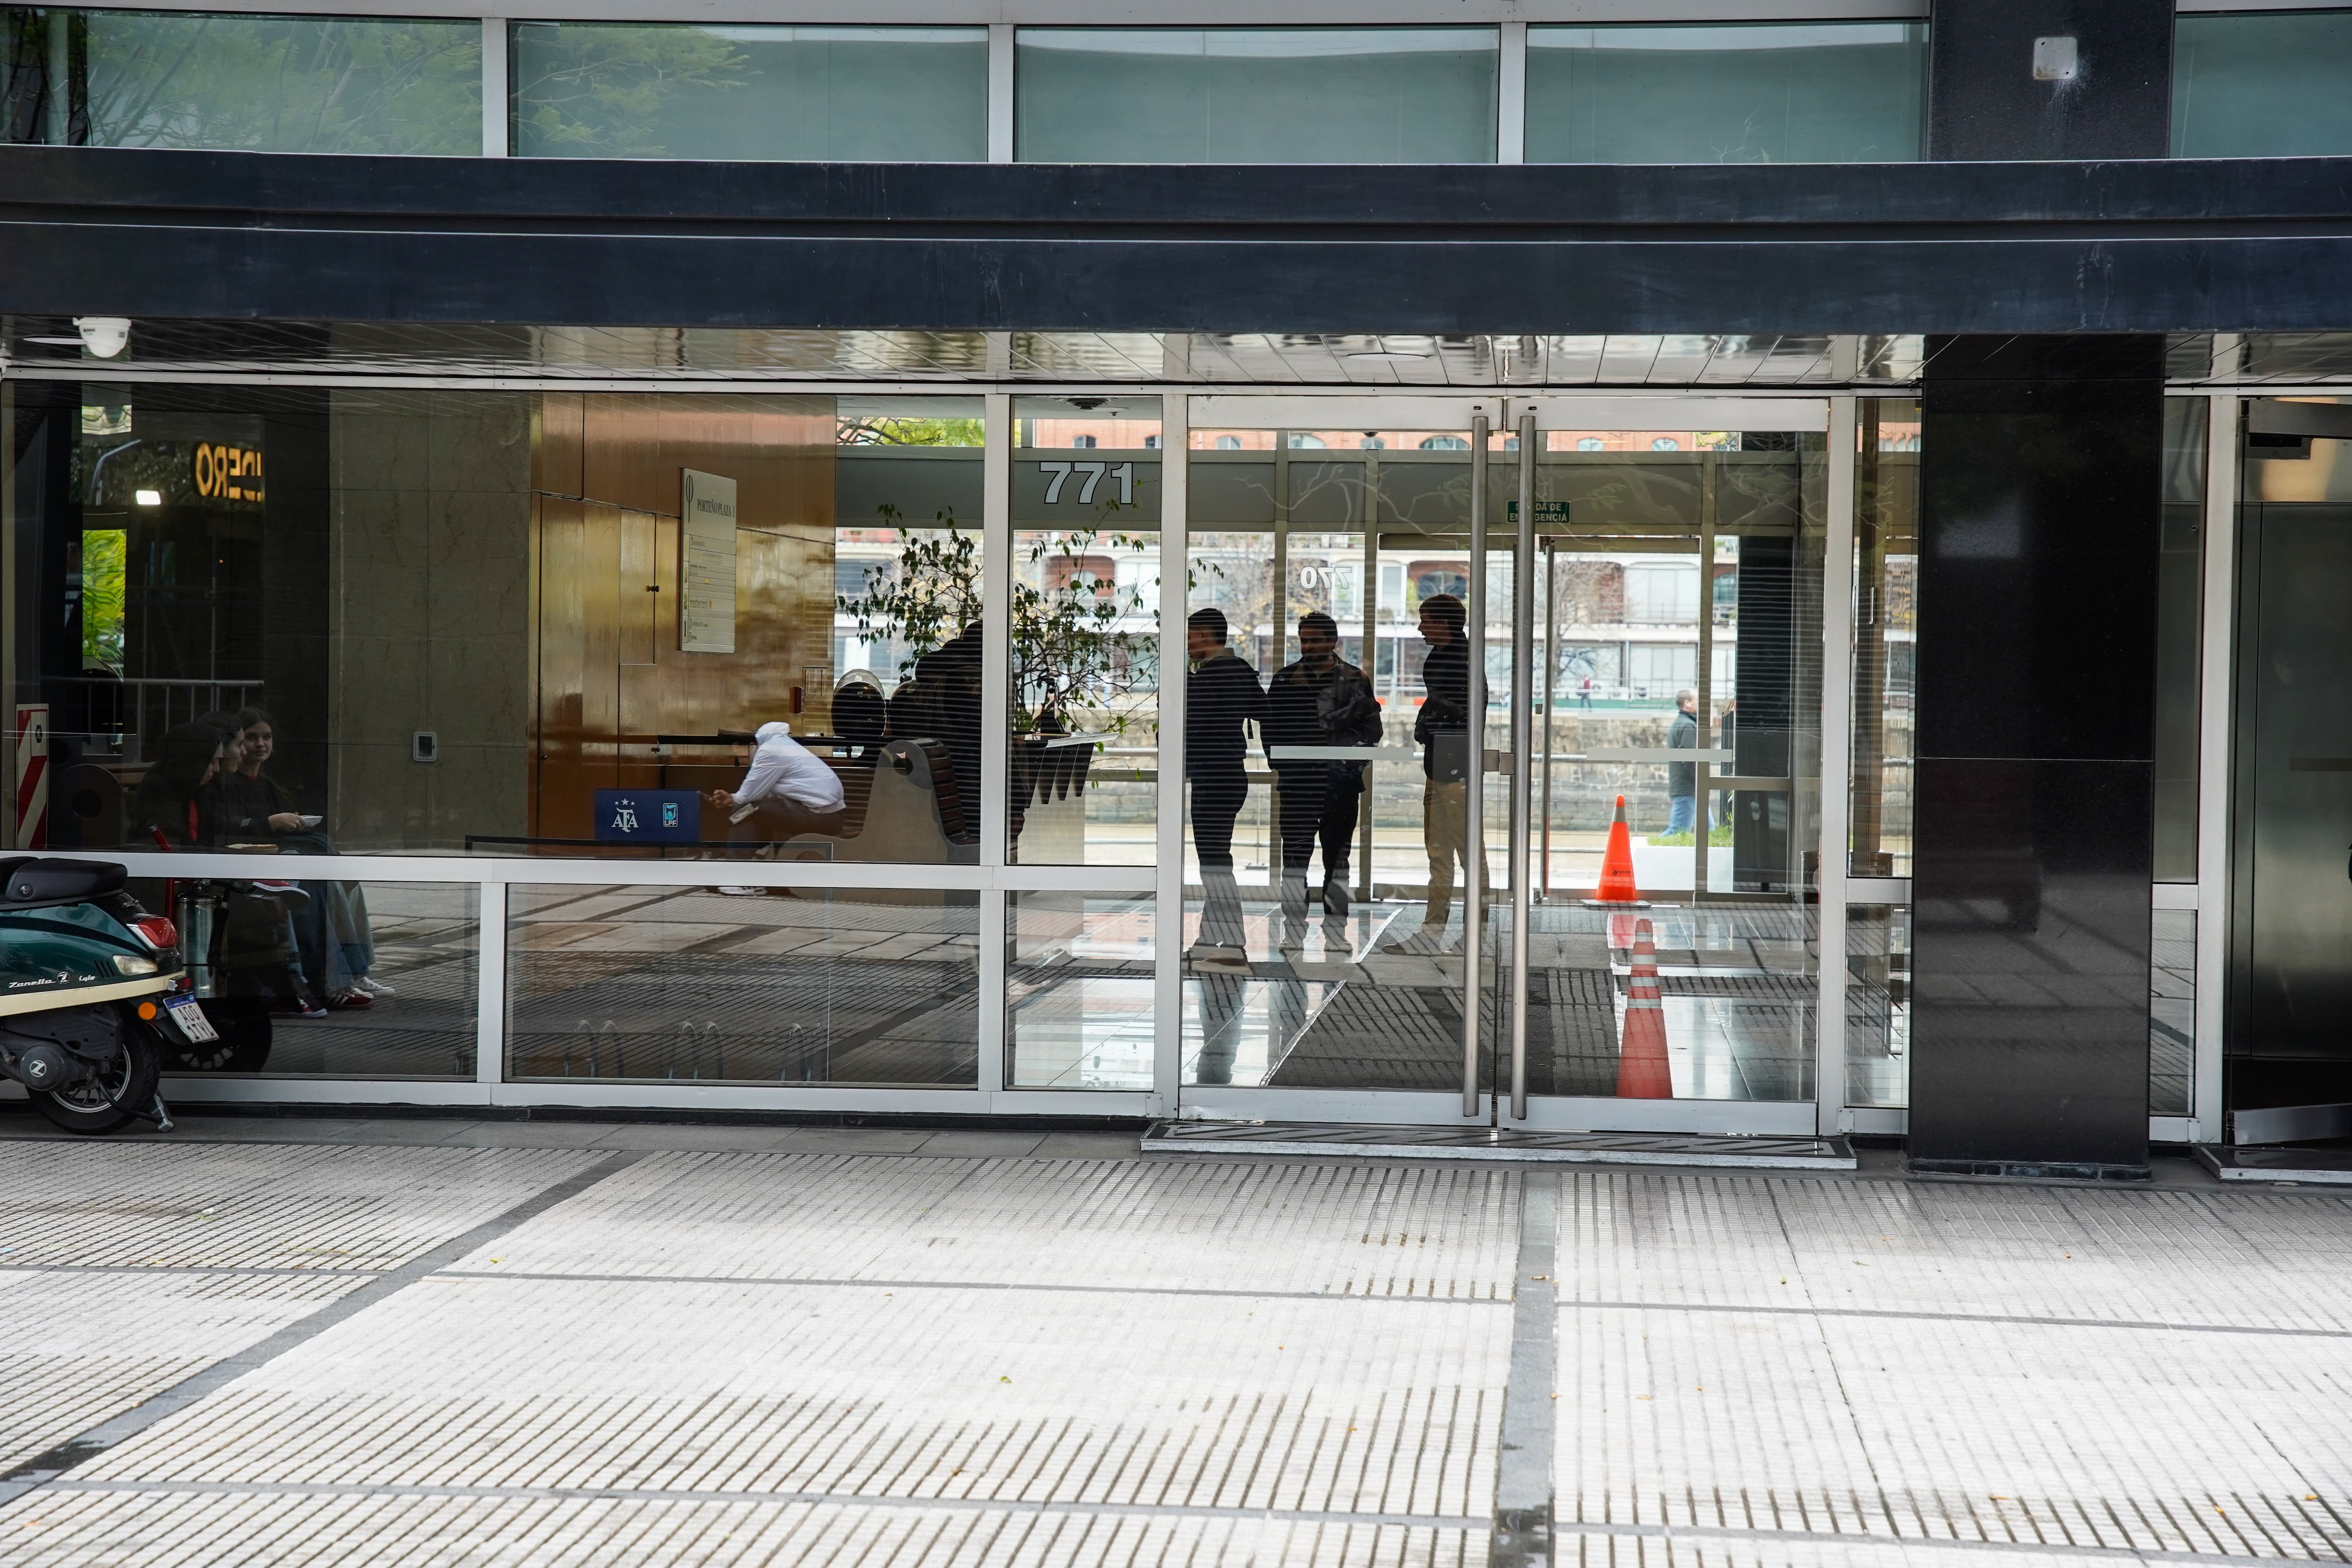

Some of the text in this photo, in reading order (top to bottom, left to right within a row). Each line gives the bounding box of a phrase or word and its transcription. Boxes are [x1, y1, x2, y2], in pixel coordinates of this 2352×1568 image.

[1039, 461, 1133, 505] 771
[697, 499, 718, 514] PORTEÑO
[718, 503, 731, 517] PLAZA
[1510, 513, 1567, 522] EGENCIA
[683, 593, 687, 610] 2
[8, 979, 56, 988] Zanella
